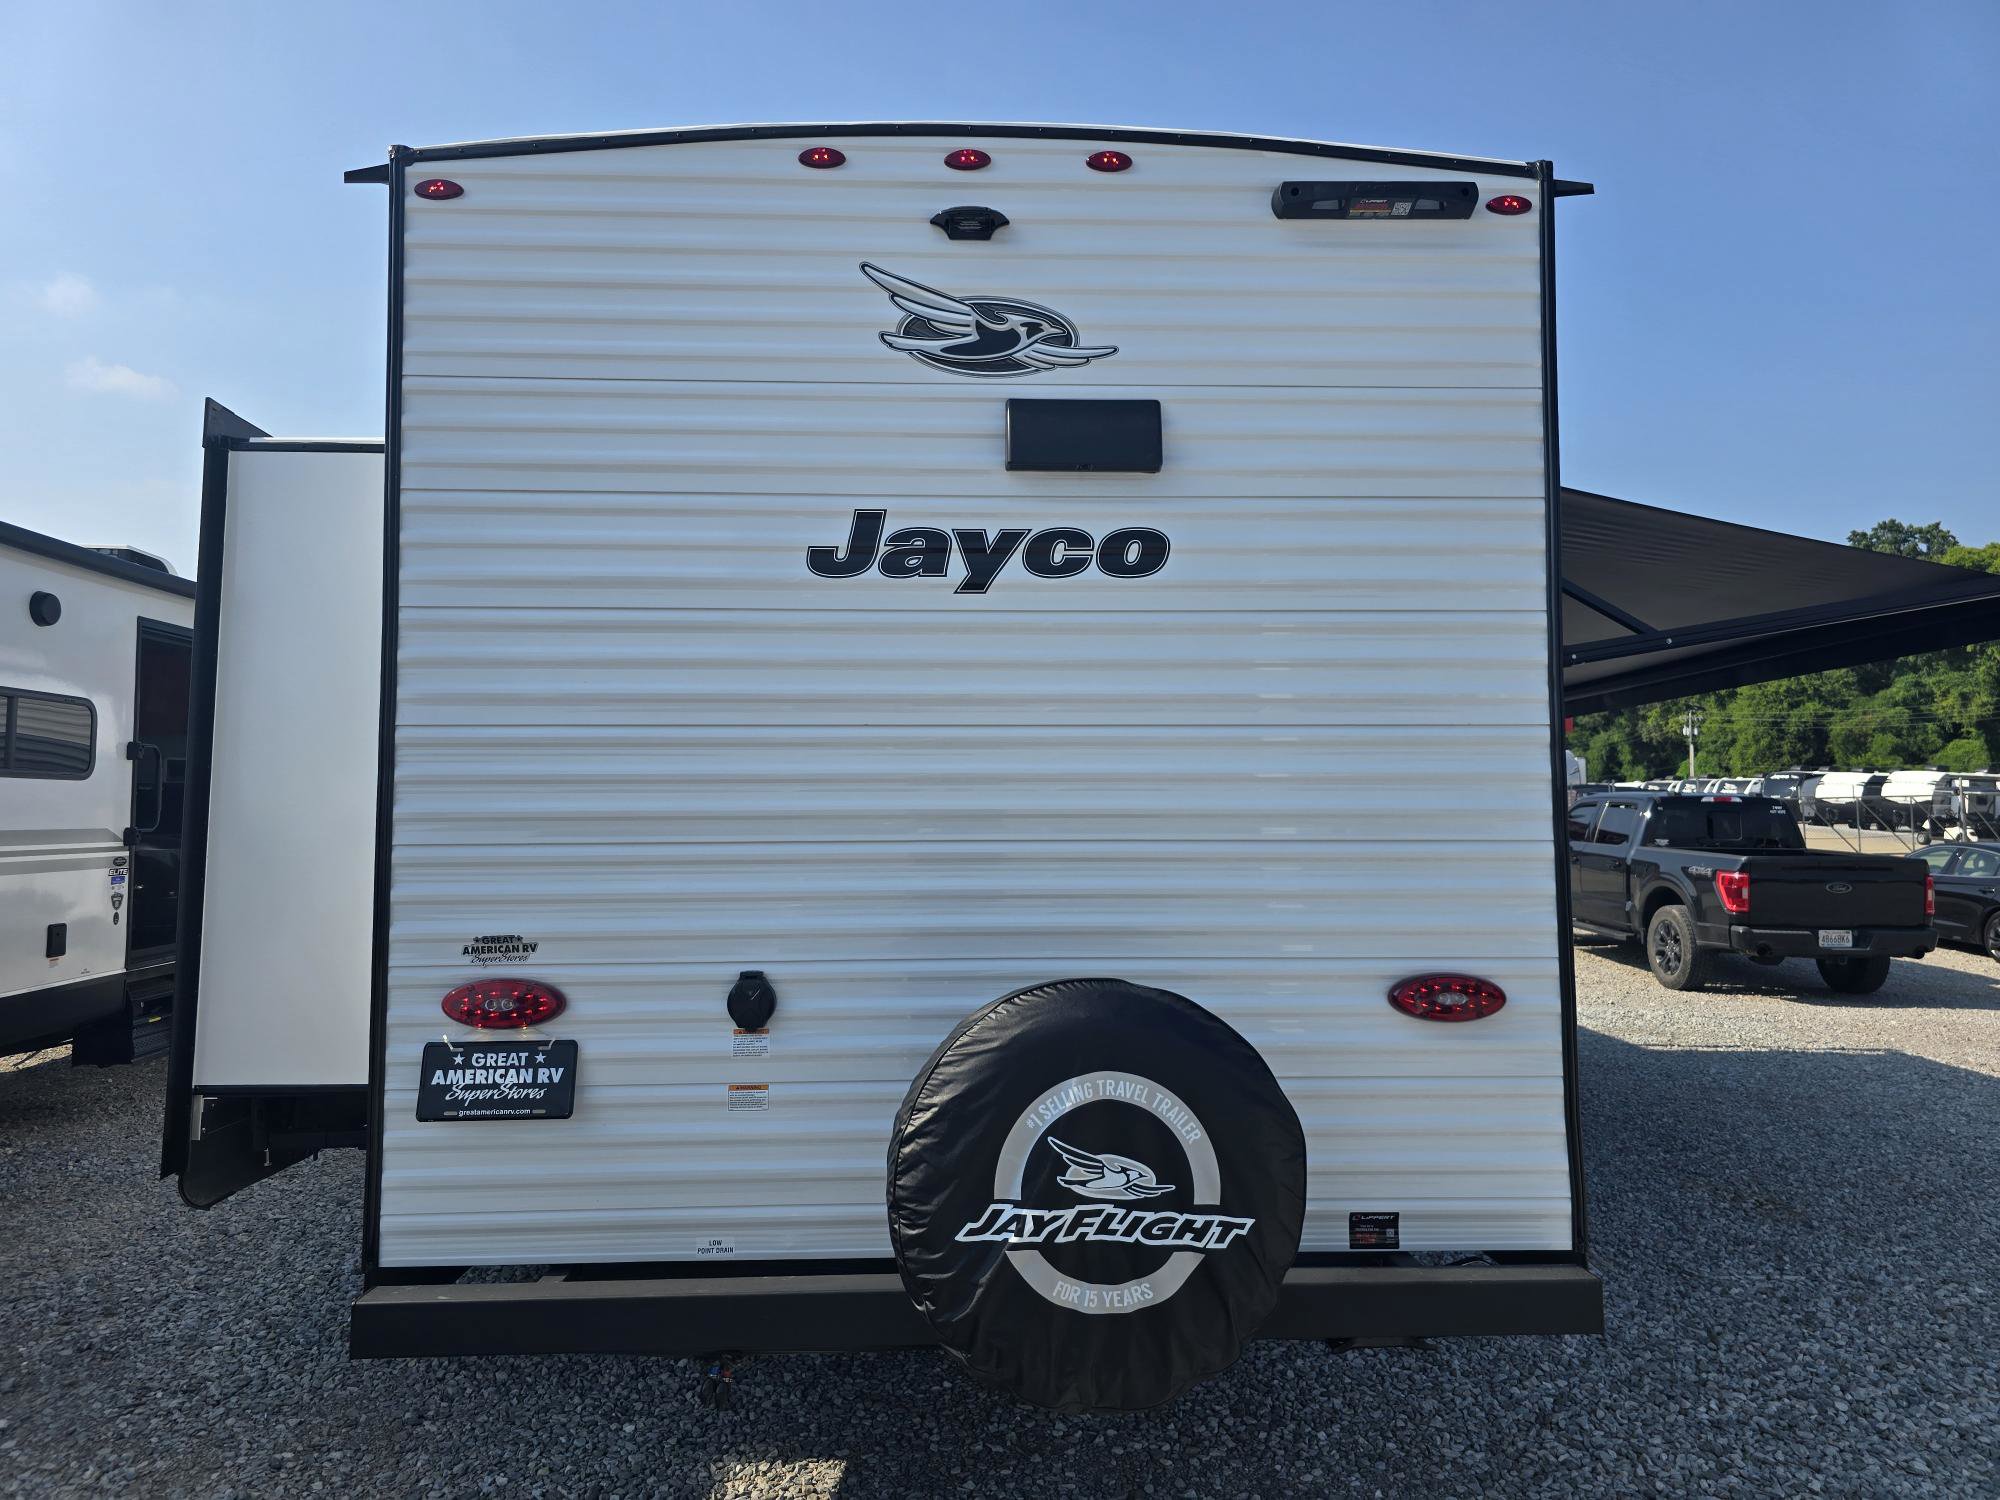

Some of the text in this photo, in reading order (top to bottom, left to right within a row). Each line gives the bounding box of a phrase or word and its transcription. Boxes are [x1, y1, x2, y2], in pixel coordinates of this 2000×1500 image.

[806, 509, 1170, 594] Jayco
[482, 936, 514, 944] GREAT
[462, 943, 537, 954] AMERICAN RV
[472, 953, 528, 967] SuperStores
[471, 1052, 528, 1067] GREAT
[431, 1067, 565, 1085] AMERICAN RV
[445, 1081, 547, 1106] SuperStores
[458, 1108, 531, 1117] greatamericanrv.com
[1025, 1079, 1201, 1144] #1 SELLING TRAVEL TRAILER
[1052, 1281, 1154, 1308] FOR 15 YEARS
